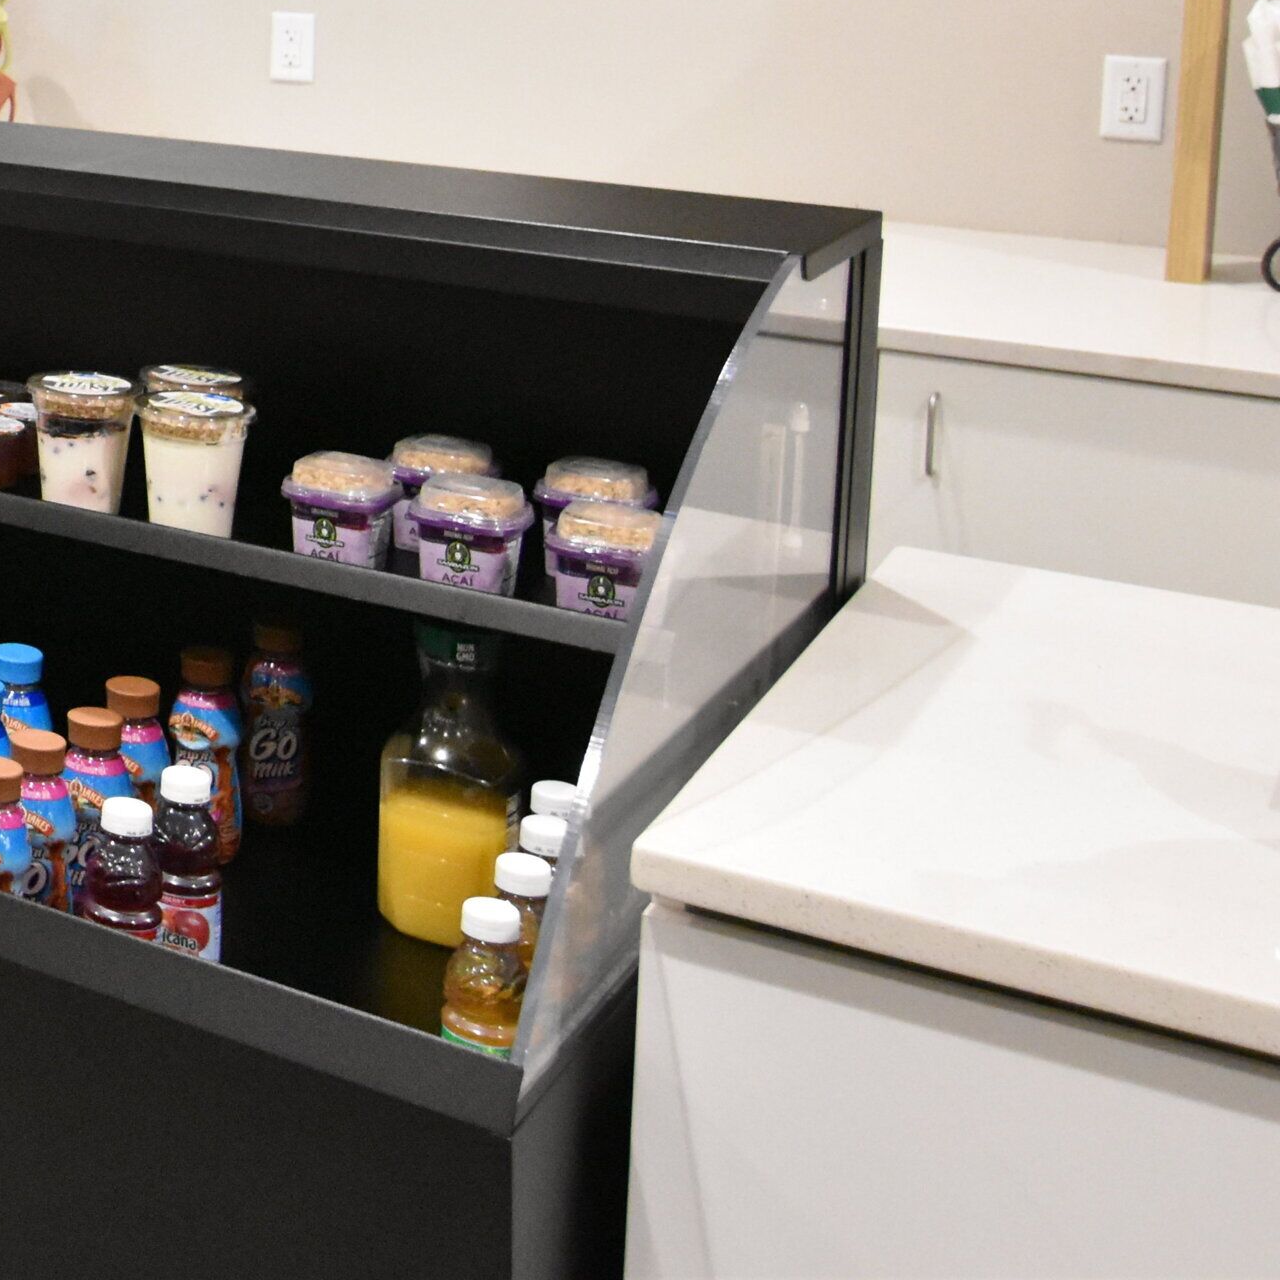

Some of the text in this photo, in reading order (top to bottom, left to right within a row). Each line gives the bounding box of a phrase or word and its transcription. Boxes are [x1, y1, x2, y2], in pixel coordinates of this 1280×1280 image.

[456, 652, 475, 662] GMO
[249, 726, 298, 761] GO
[26, 811, 54, 837] LAKES
[162, 930, 198, 951] icana
